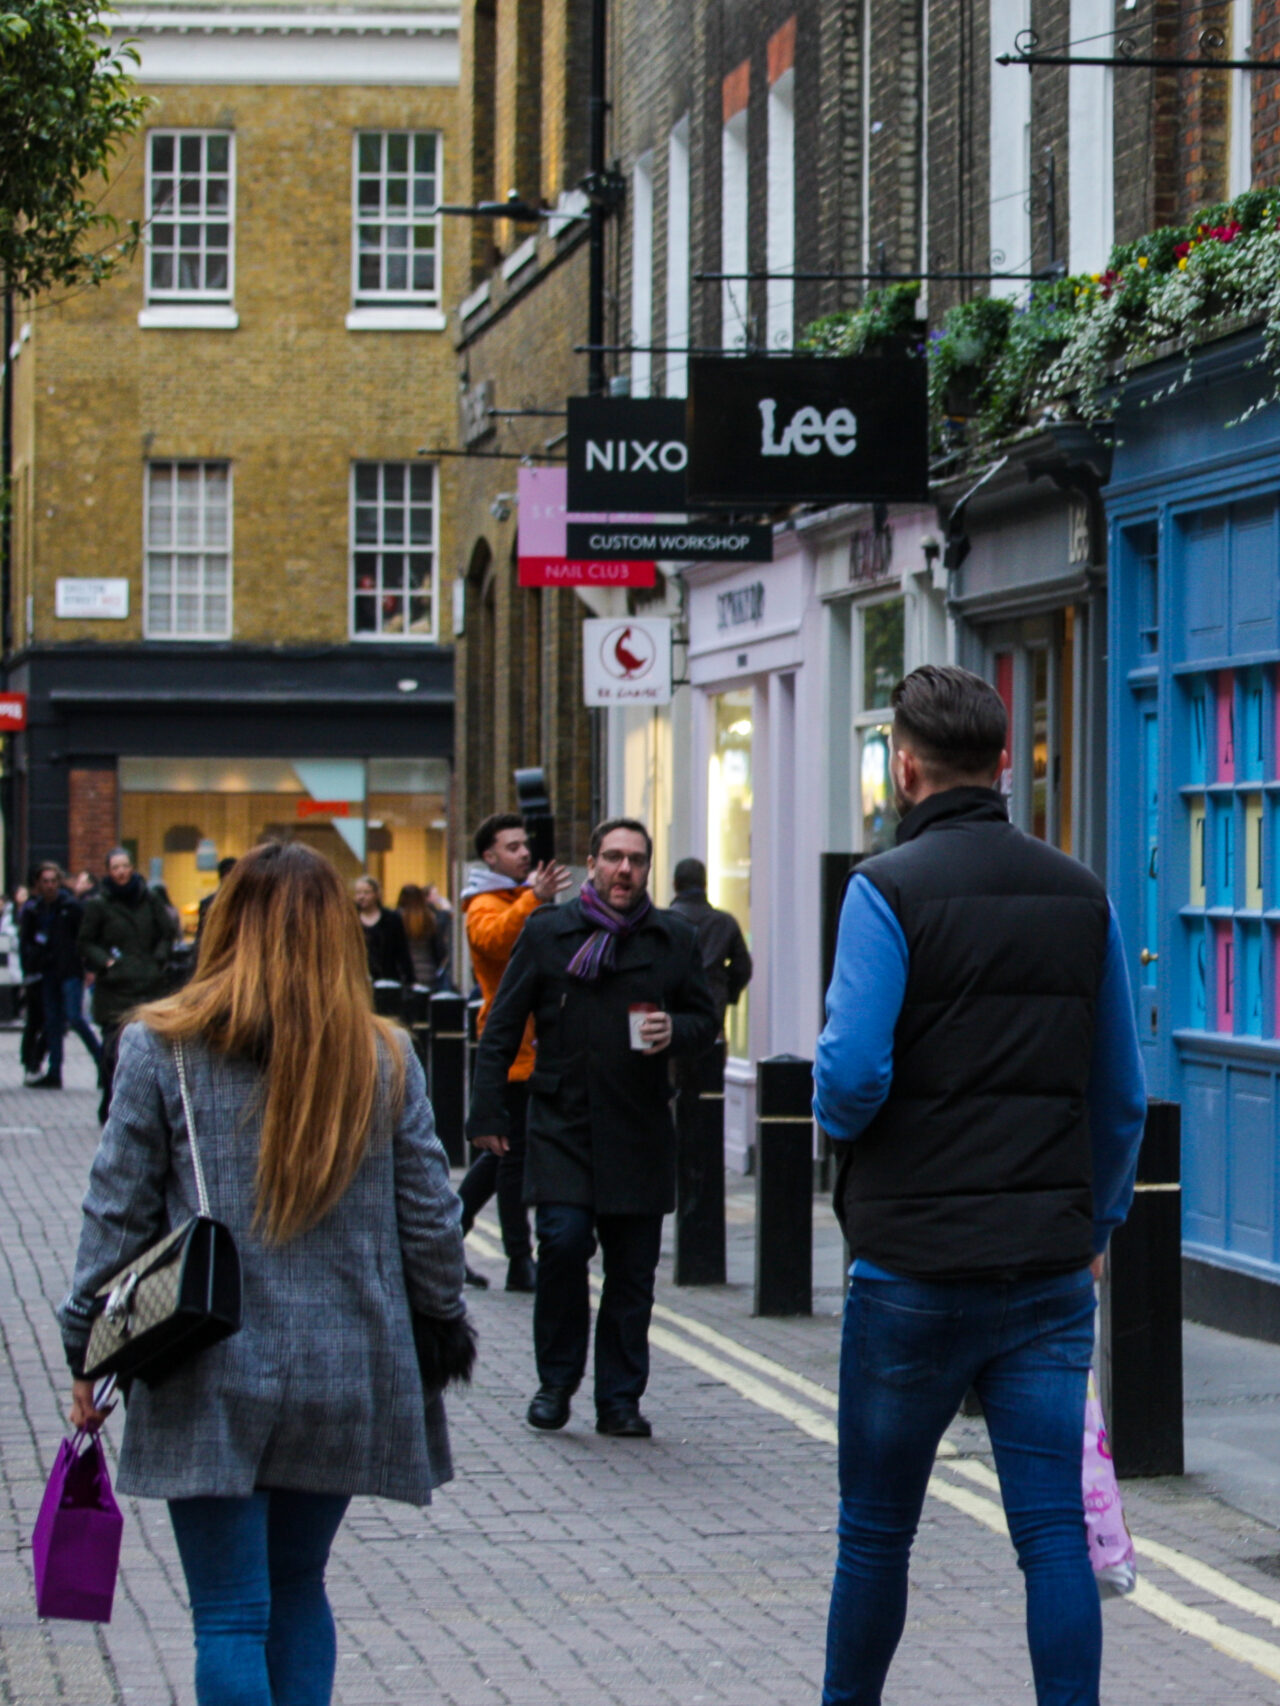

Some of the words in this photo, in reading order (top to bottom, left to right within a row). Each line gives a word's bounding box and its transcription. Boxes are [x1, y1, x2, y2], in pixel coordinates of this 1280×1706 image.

[758, 398, 857, 456] Lee
[589, 533, 656, 550] CUSTOM
[660, 534, 749, 550] WORKSHOP
[545, 564, 583, 579] NAIL
